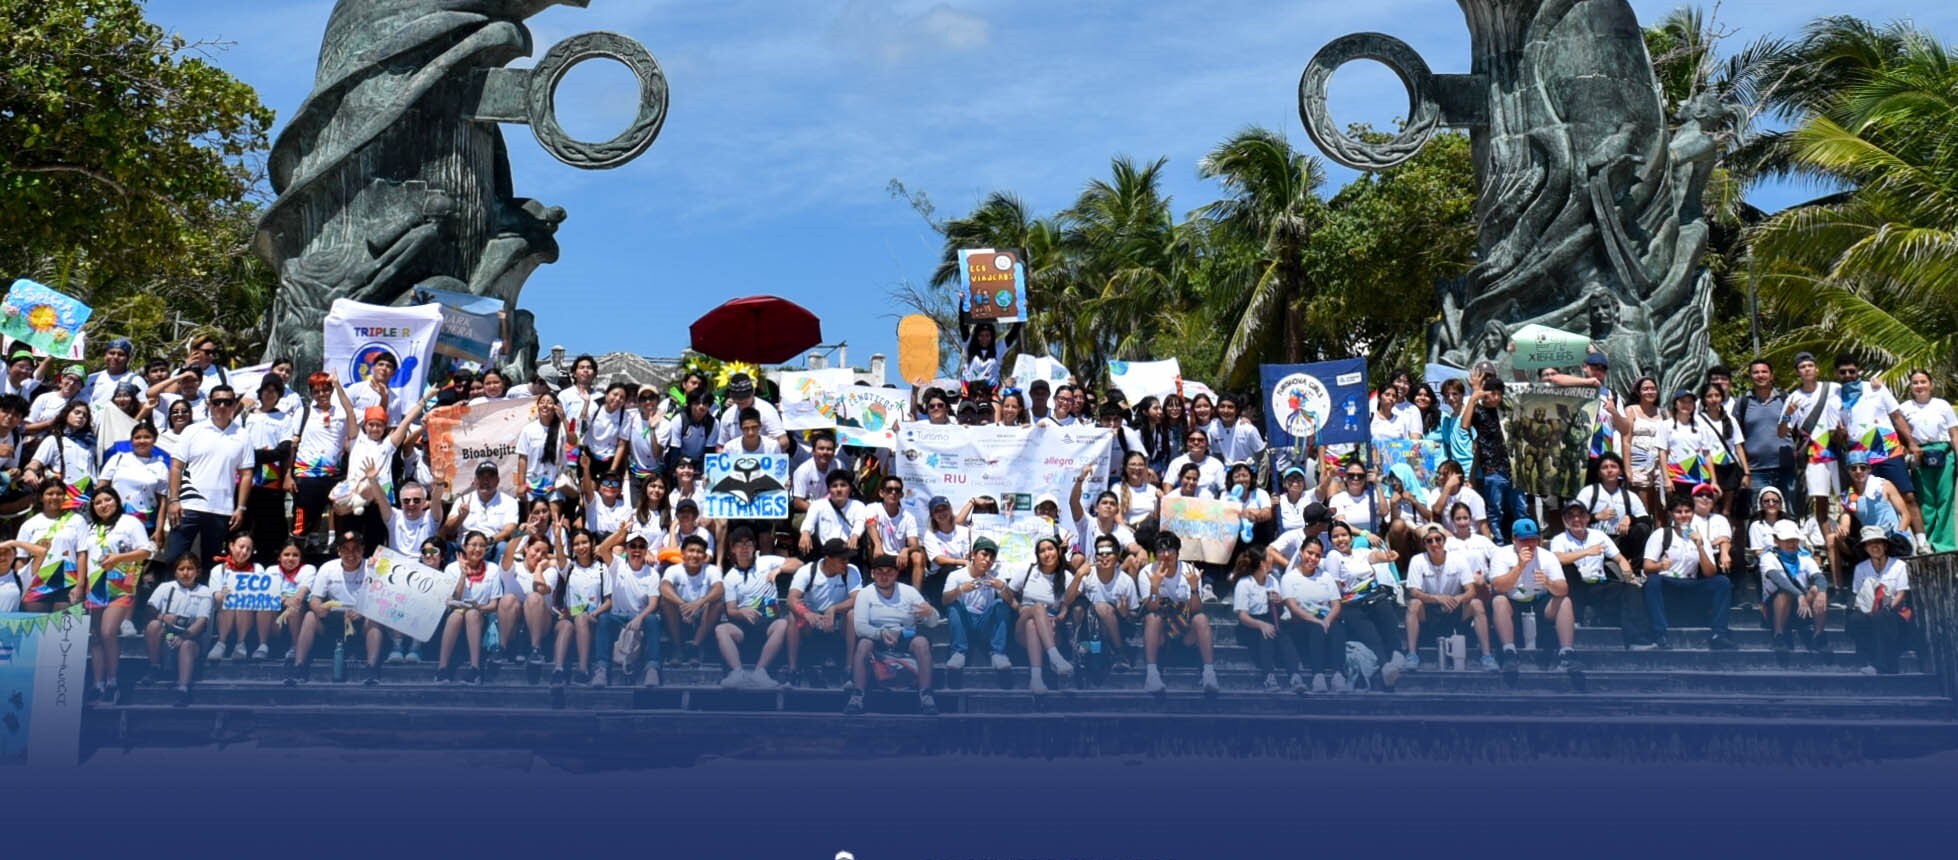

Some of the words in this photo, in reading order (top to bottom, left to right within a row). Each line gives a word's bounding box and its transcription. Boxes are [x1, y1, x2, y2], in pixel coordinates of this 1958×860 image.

[353, 327, 397, 337] TRIPLE
[402, 328, 410, 337] R
[917, 431, 950, 441] Turismo
[1044, 456, 1074, 467] allegro
[944, 473, 967, 484] RIU
[705, 495, 787, 517] TITANES
[235, 574, 272, 591] ECO
[224, 593, 281, 611] SHARKS
